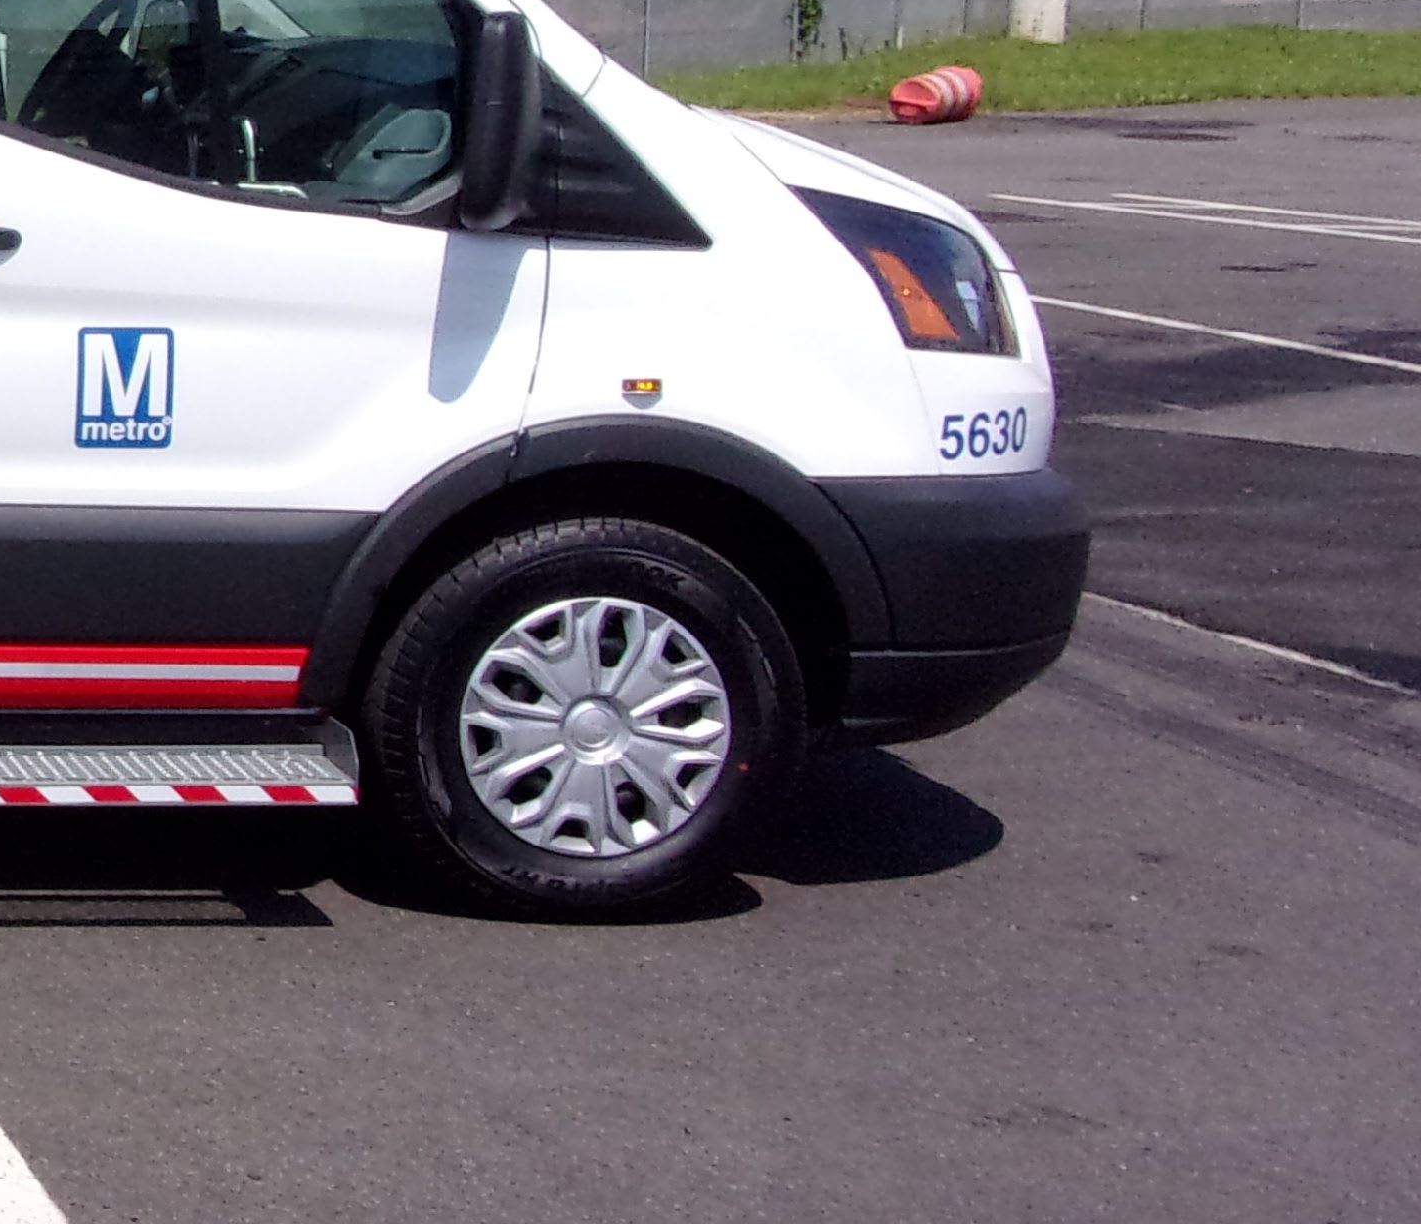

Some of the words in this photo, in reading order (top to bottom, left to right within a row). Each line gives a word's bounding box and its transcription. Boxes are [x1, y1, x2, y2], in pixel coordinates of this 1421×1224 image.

[82, 333, 169, 417] M
[82, 419, 167, 441] metro
[939, 406, 1028, 461] 5630
